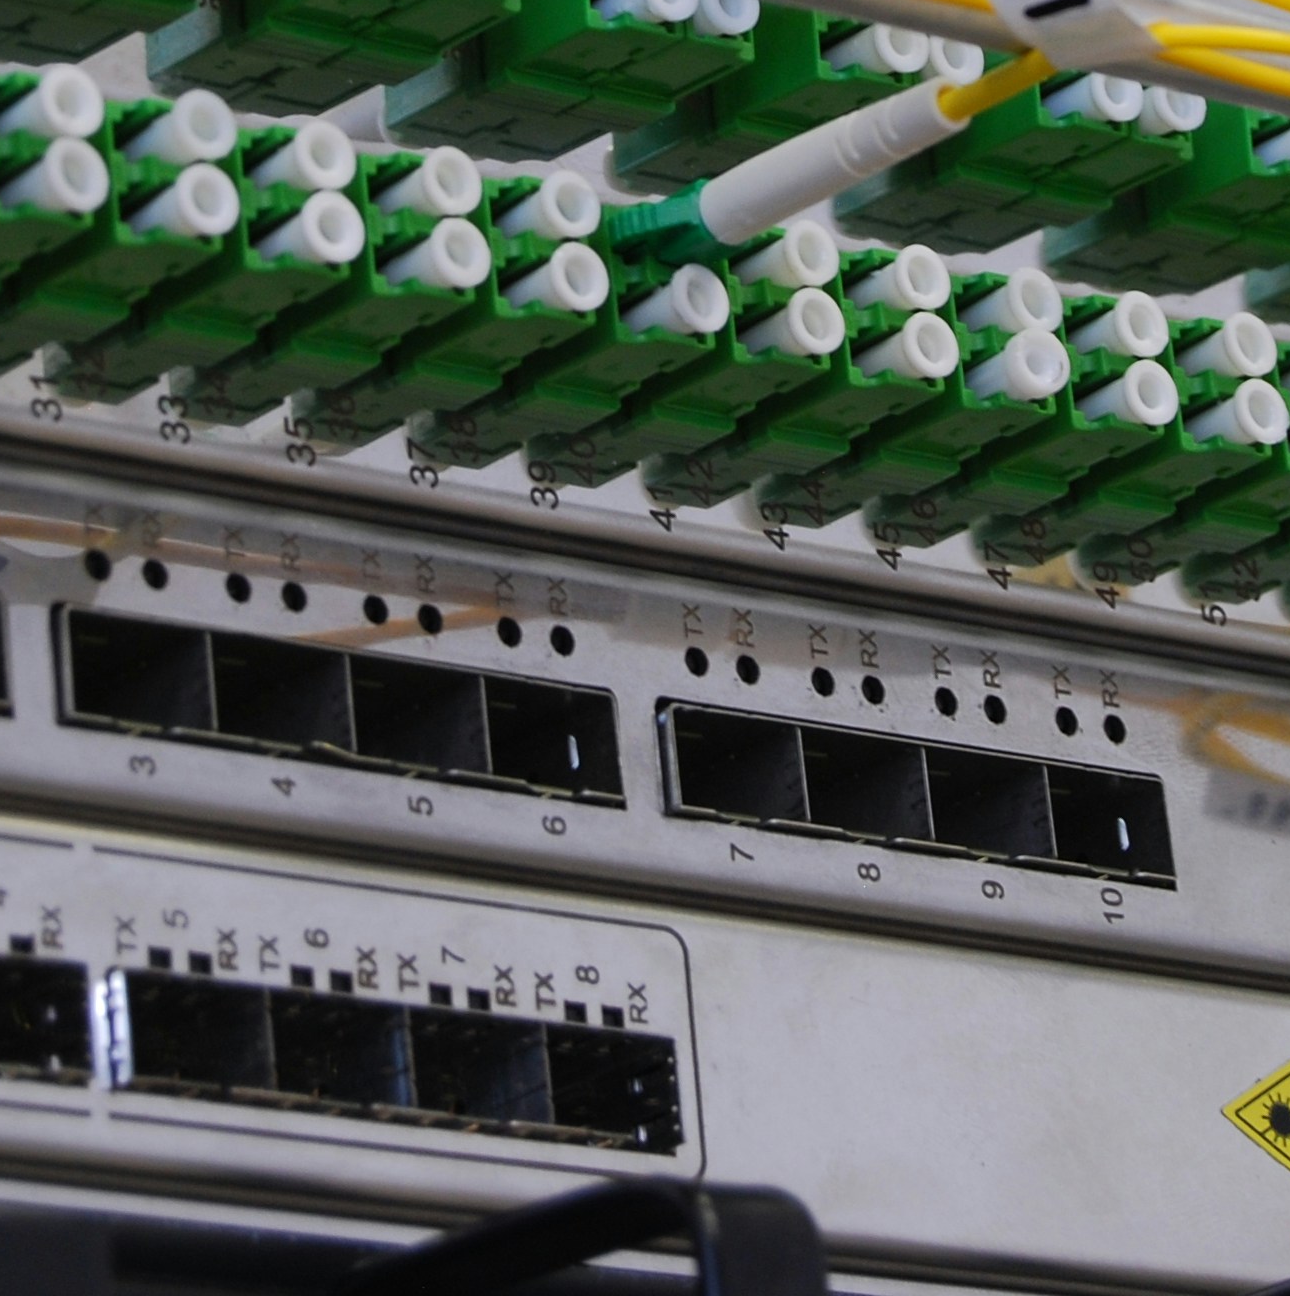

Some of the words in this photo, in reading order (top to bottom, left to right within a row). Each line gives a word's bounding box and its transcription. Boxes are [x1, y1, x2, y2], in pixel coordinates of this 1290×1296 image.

[29, 373, 62, 422] 31
[157, 395, 191, 445] 33
[284, 415, 316, 467] 35
[406, 436, 440, 489] 37
[527, 459, 559, 510] 39
[648, 486, 677, 532] 41
[761, 503, 790, 552] 43
[872, 522, 903, 571] 45
[982, 540, 1013, 590] 47
[547, 577, 568, 616] RX
[1092, 560, 1121, 610] 49
[681, 603, 703, 638] TX
[732, 607, 756, 649] RX
[809, 623, 830, 659] TX
[858, 628, 880, 669] RX
[930, 644, 953, 679] TX
[979, 649, 1002, 689] RX
[1051, 664, 1073, 699] TX
[1098, 669, 1121, 709] RX
[129, 754, 156, 777] 3
[271, 775, 297, 797] 4
[408, 795, 434, 817] 5
[541, 814, 567, 836] 6
[730, 842, 756, 863] 7
[857, 861, 882, 883] 8
[980, 879, 1006, 901] 9
[1100, 887, 1125, 925] 10
[114, 915, 138, 954] TX
[162, 908, 190, 930] 5
[303, 927, 330, 949] 6
[217, 927, 239, 971] RX
[258, 935, 281, 972] TX
[355, 946, 379, 990] RX
[440, 945, 466, 964] 7
[396, 952, 420, 992] TX
[493, 964, 517, 1008] RX
[533, 971, 557, 1010] TX
[574, 964, 600, 985] 8
[626, 981, 649, 1025] RX
